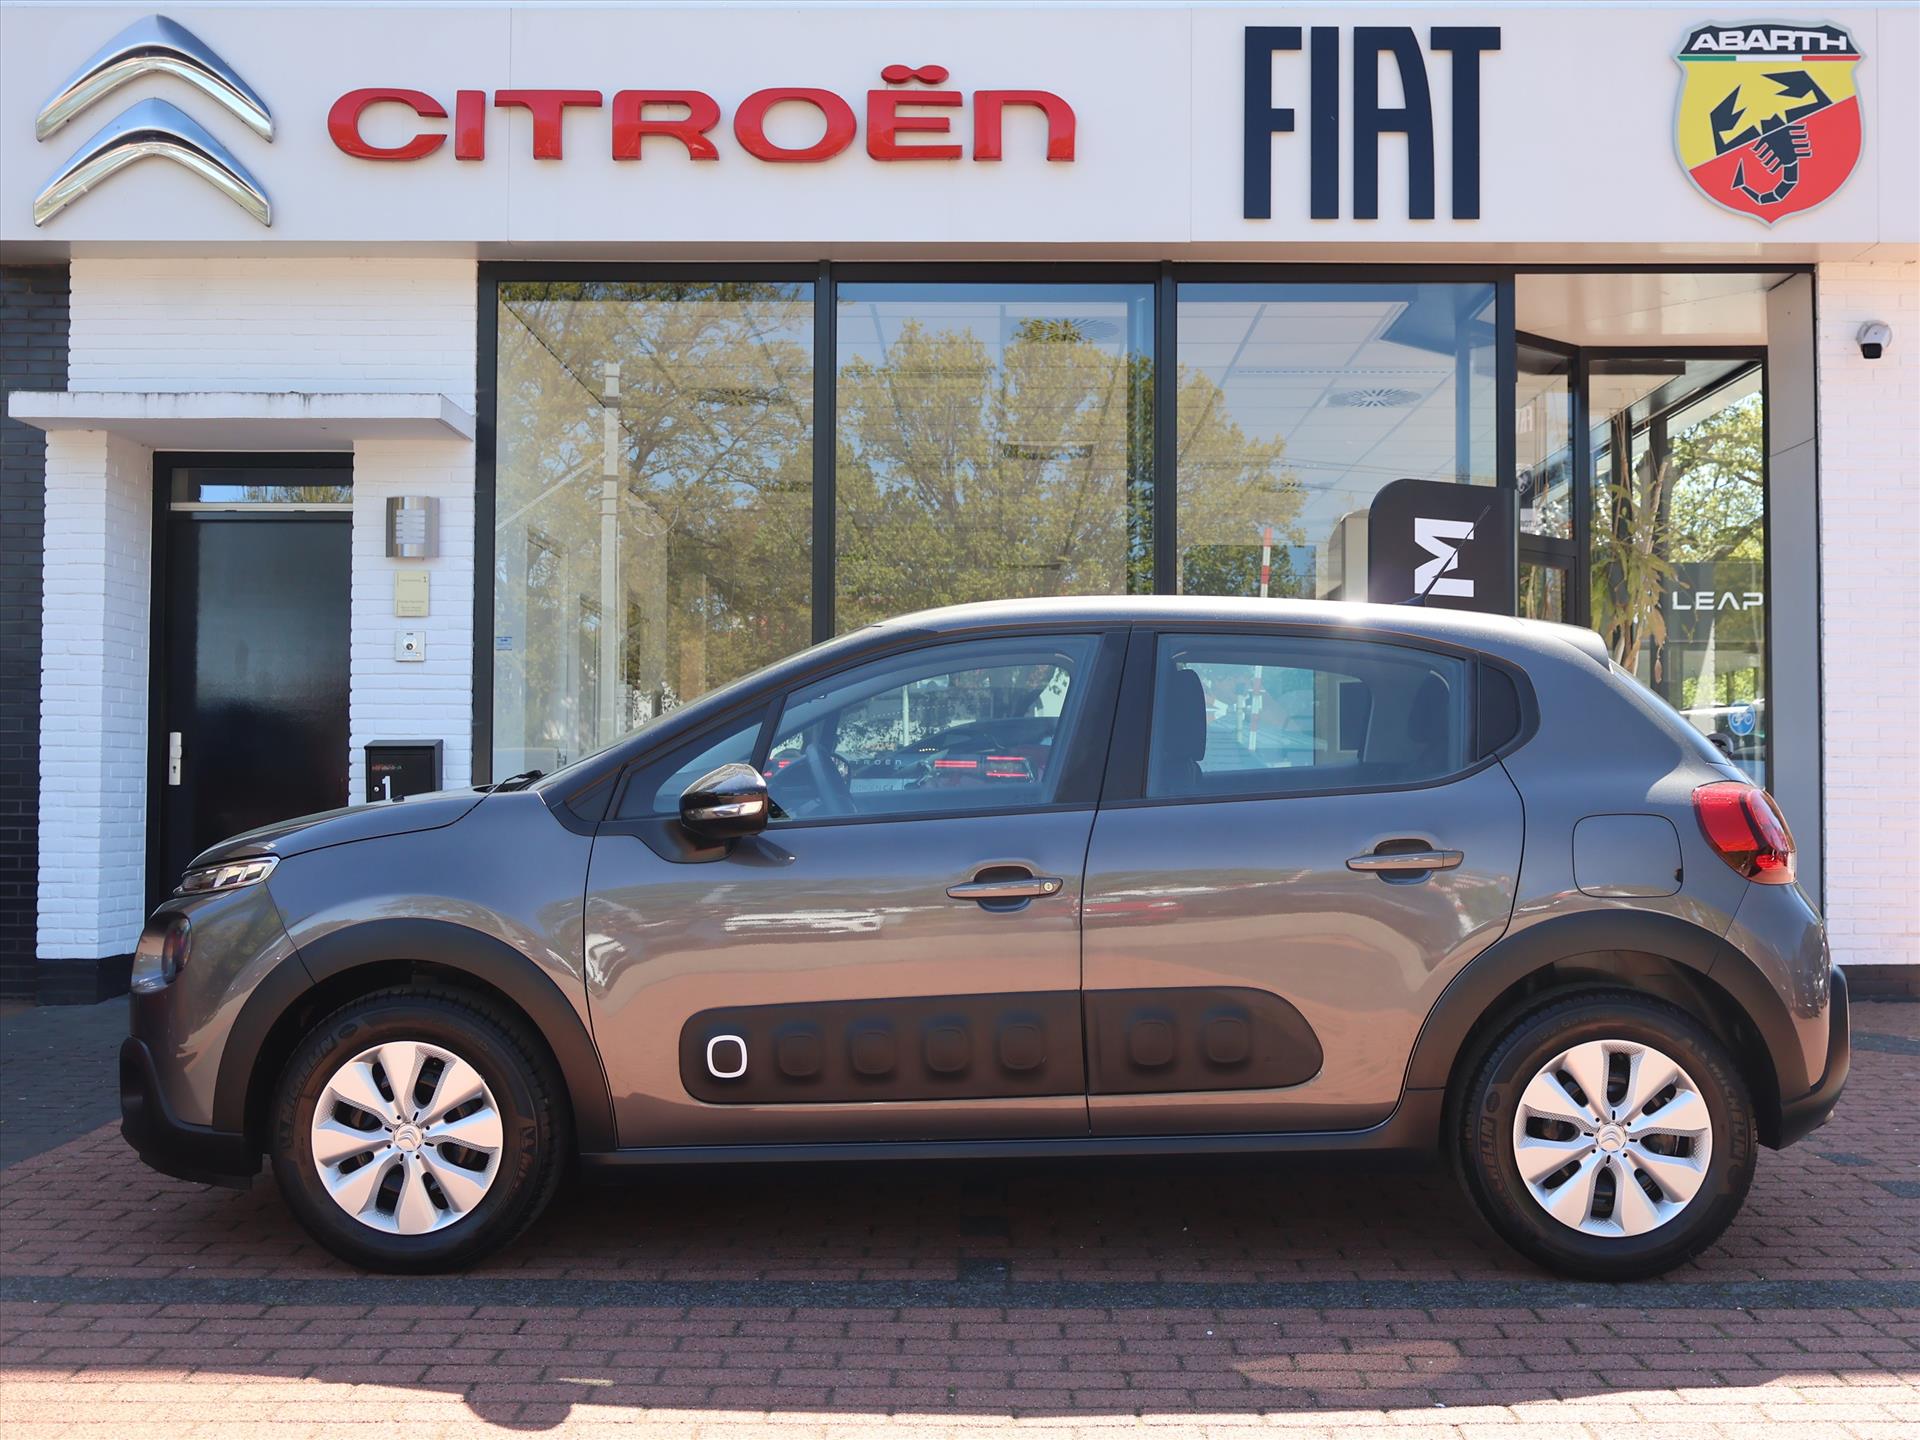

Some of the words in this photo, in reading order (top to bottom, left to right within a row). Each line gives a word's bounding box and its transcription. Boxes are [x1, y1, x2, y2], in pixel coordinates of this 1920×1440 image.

[1690, 29, 1848, 51] ABARTH
[1244, 26, 1501, 220] FIAT
[382, 775, 391, 800] 1
